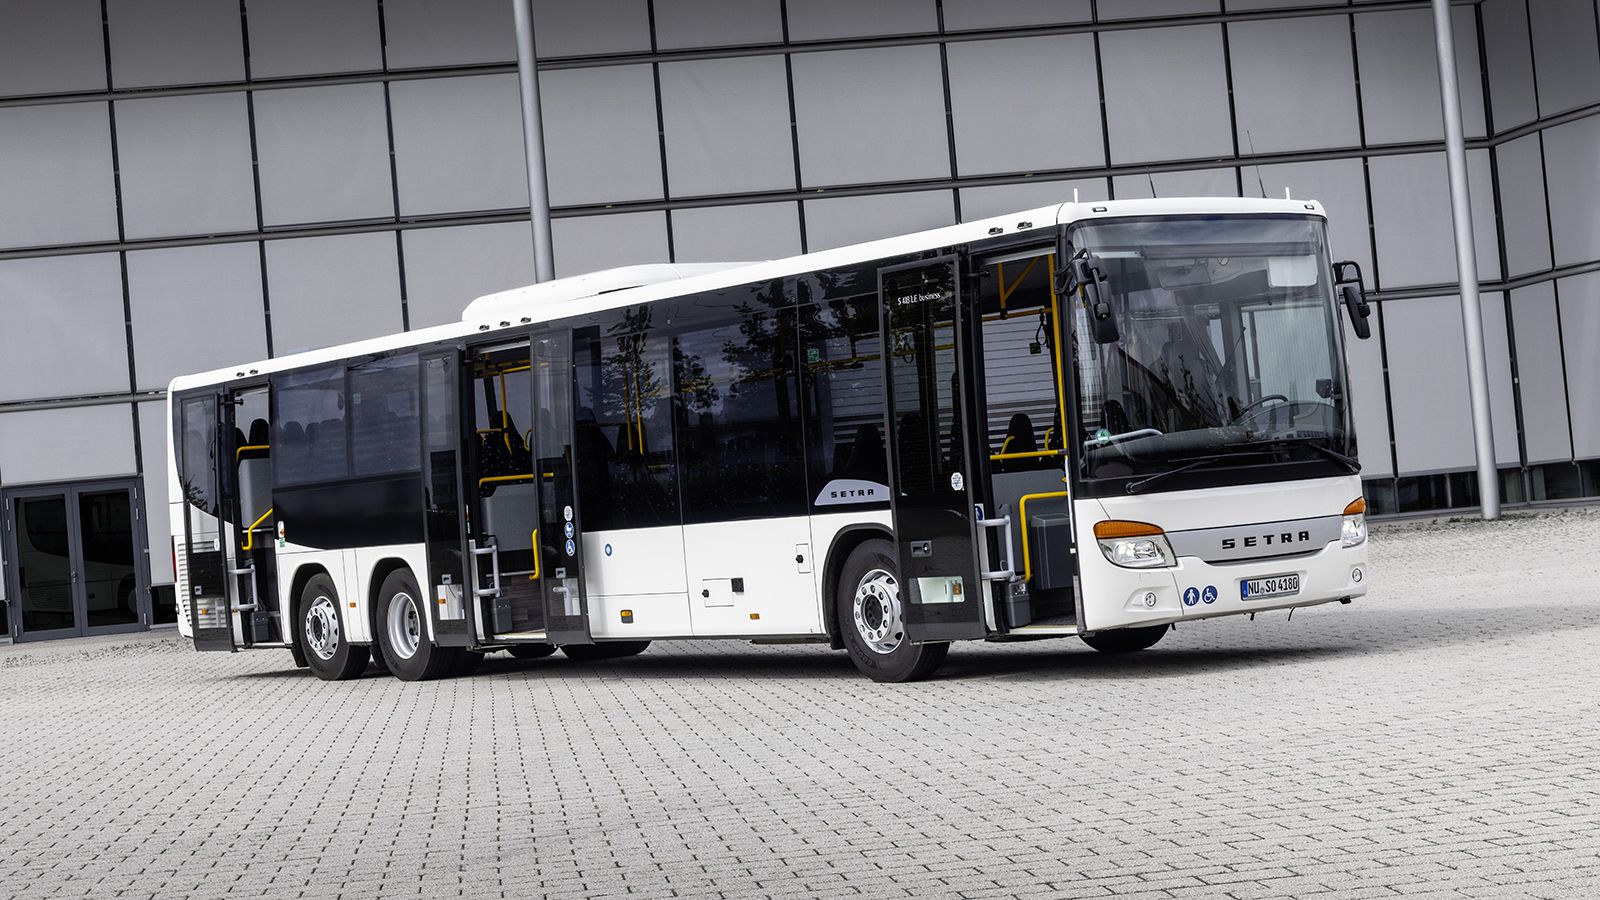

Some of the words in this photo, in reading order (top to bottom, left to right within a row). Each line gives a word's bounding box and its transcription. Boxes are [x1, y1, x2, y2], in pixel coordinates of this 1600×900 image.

[897, 296, 902, 306] S
[830, 488, 874, 499] SETRA
[1221, 530, 1310, 550] SETRA
[1248, 581, 1260, 595] NU
[1265, 579, 1277, 593] SO
[1278, 576, 1298, 592] 4180
